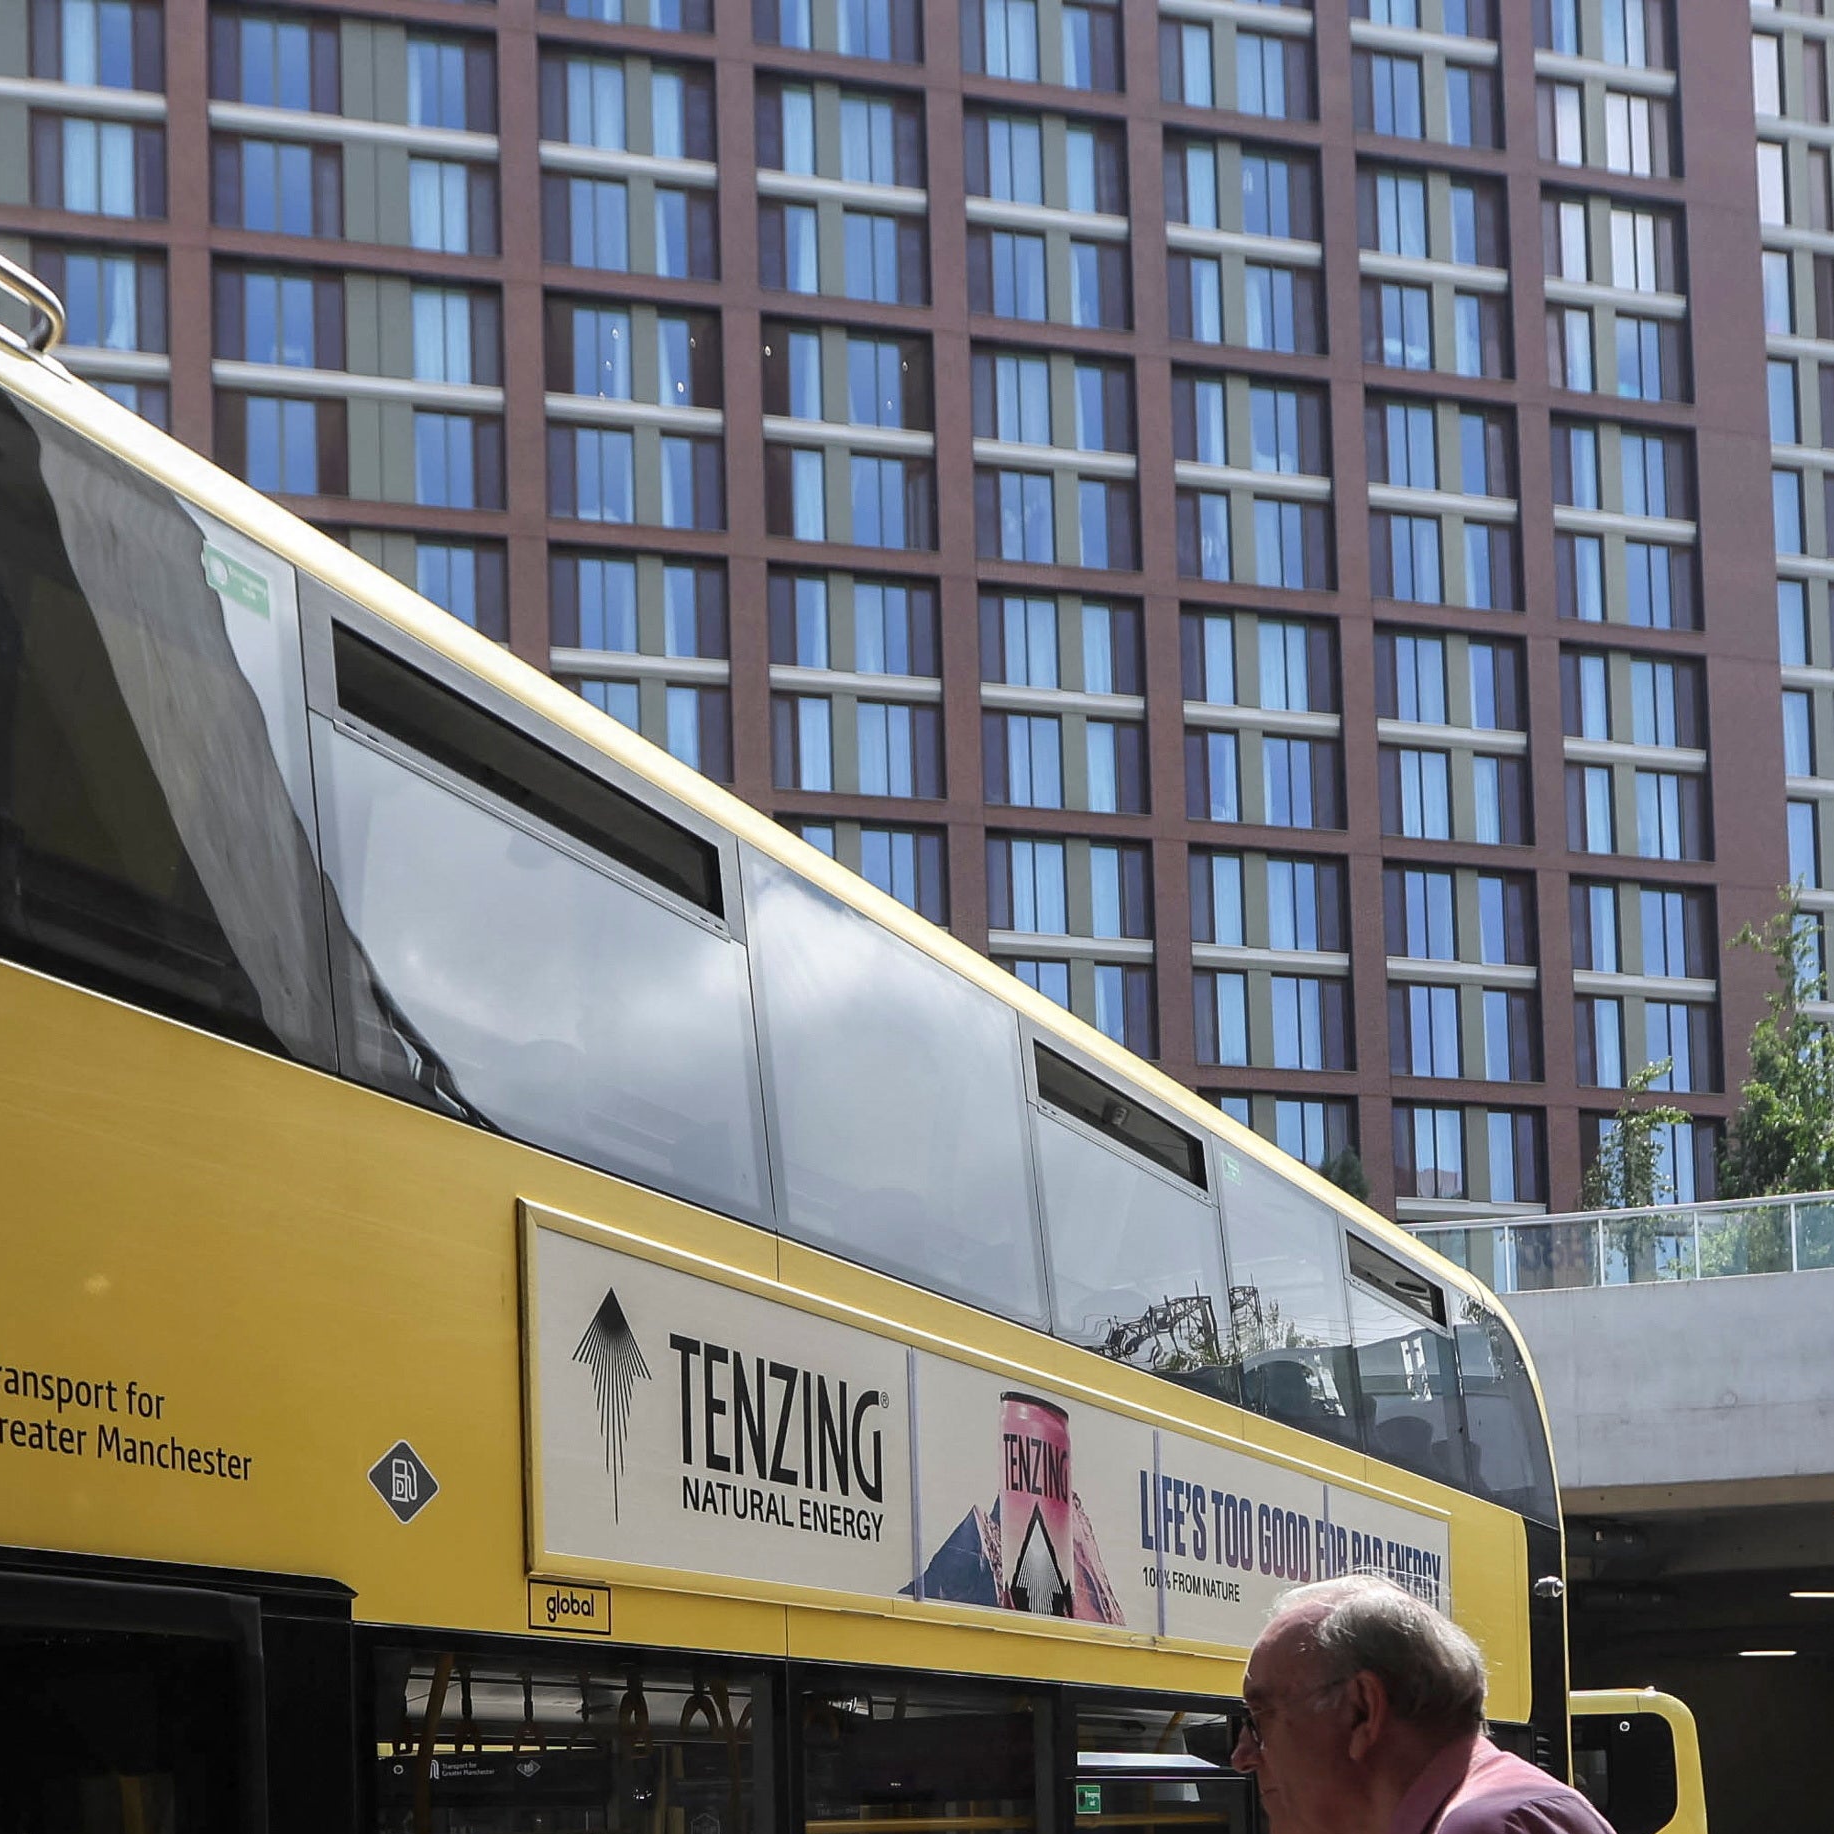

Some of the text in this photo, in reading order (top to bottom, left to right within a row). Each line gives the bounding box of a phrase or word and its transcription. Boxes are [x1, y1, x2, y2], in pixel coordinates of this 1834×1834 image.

[126, 1381, 166, 1420] for
[97, 1424, 253, 1481] Manchester
[682, 1475, 884, 1543] NATURAL ENERGY
[1139, 1469, 1207, 1562] LIFE'S
[1211, 1488, 1254, 1572] TOO
[1258, 1502, 1312, 1584] GOOD
[1315, 1518, 1349, 1582] FOR
[1351, 1529, 1384, 1575] BAD
[546, 1589, 595, 1624] global
[1142, 1567, 1241, 1603] 100% FROM NATURE
